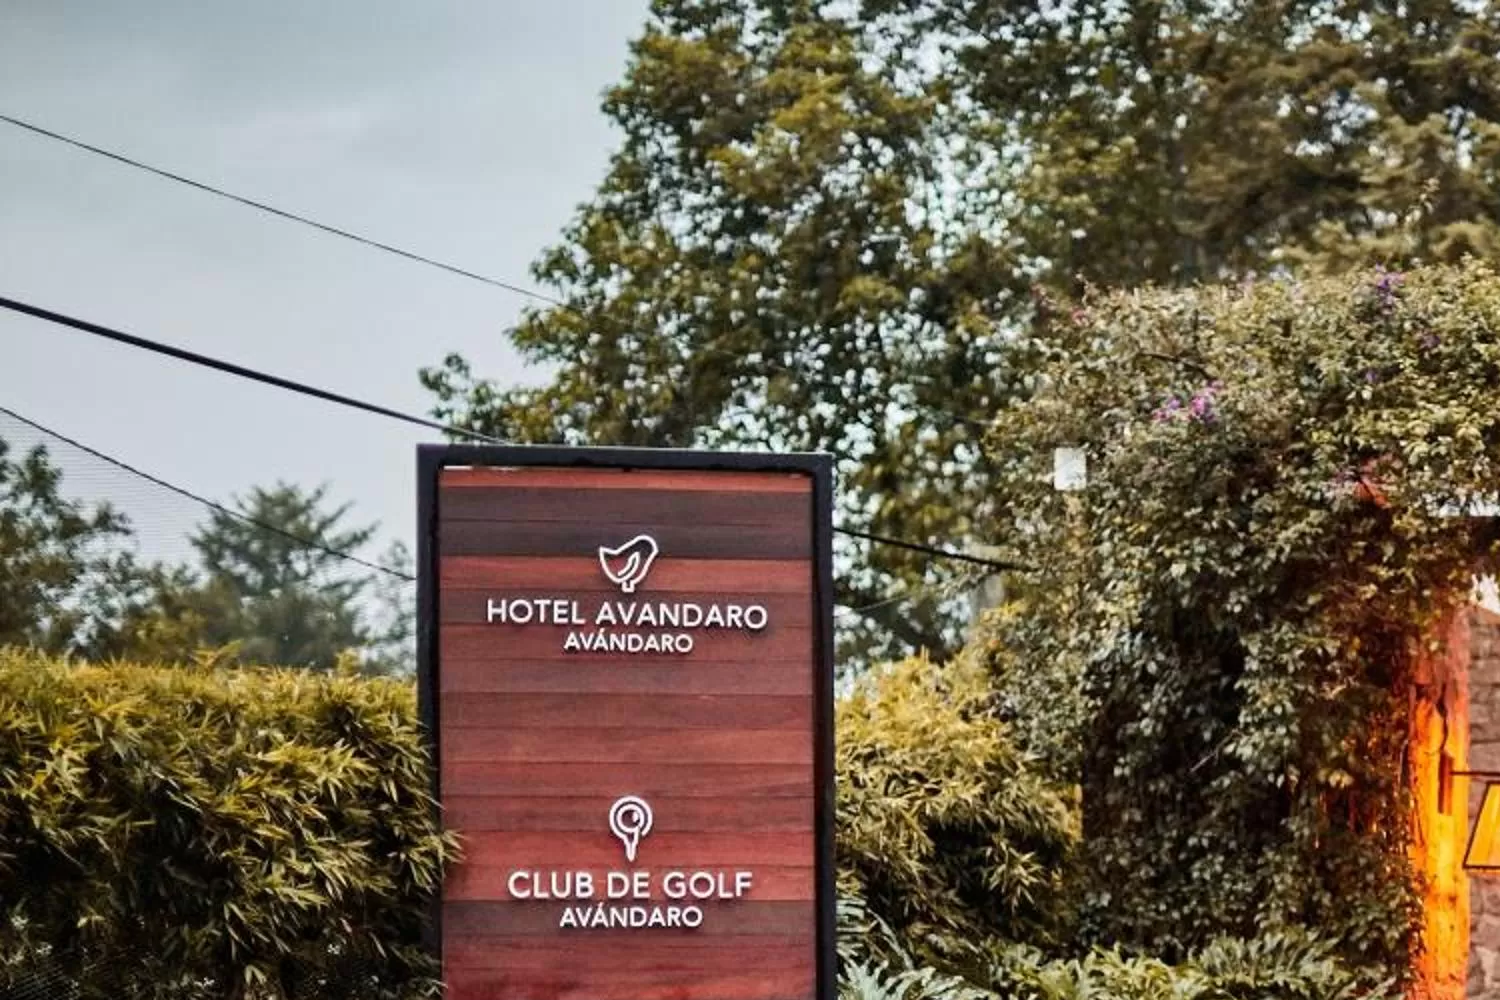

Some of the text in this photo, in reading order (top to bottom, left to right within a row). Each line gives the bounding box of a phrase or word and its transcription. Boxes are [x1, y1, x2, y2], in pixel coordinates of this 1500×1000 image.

[487, 598, 769, 629] HOTEL AVANDARO
[563, 627, 694, 653] AVÁNDARO
[507, 868, 753, 899] CLUB DE GOLF
[559, 901, 704, 928] AVÁNDARO
